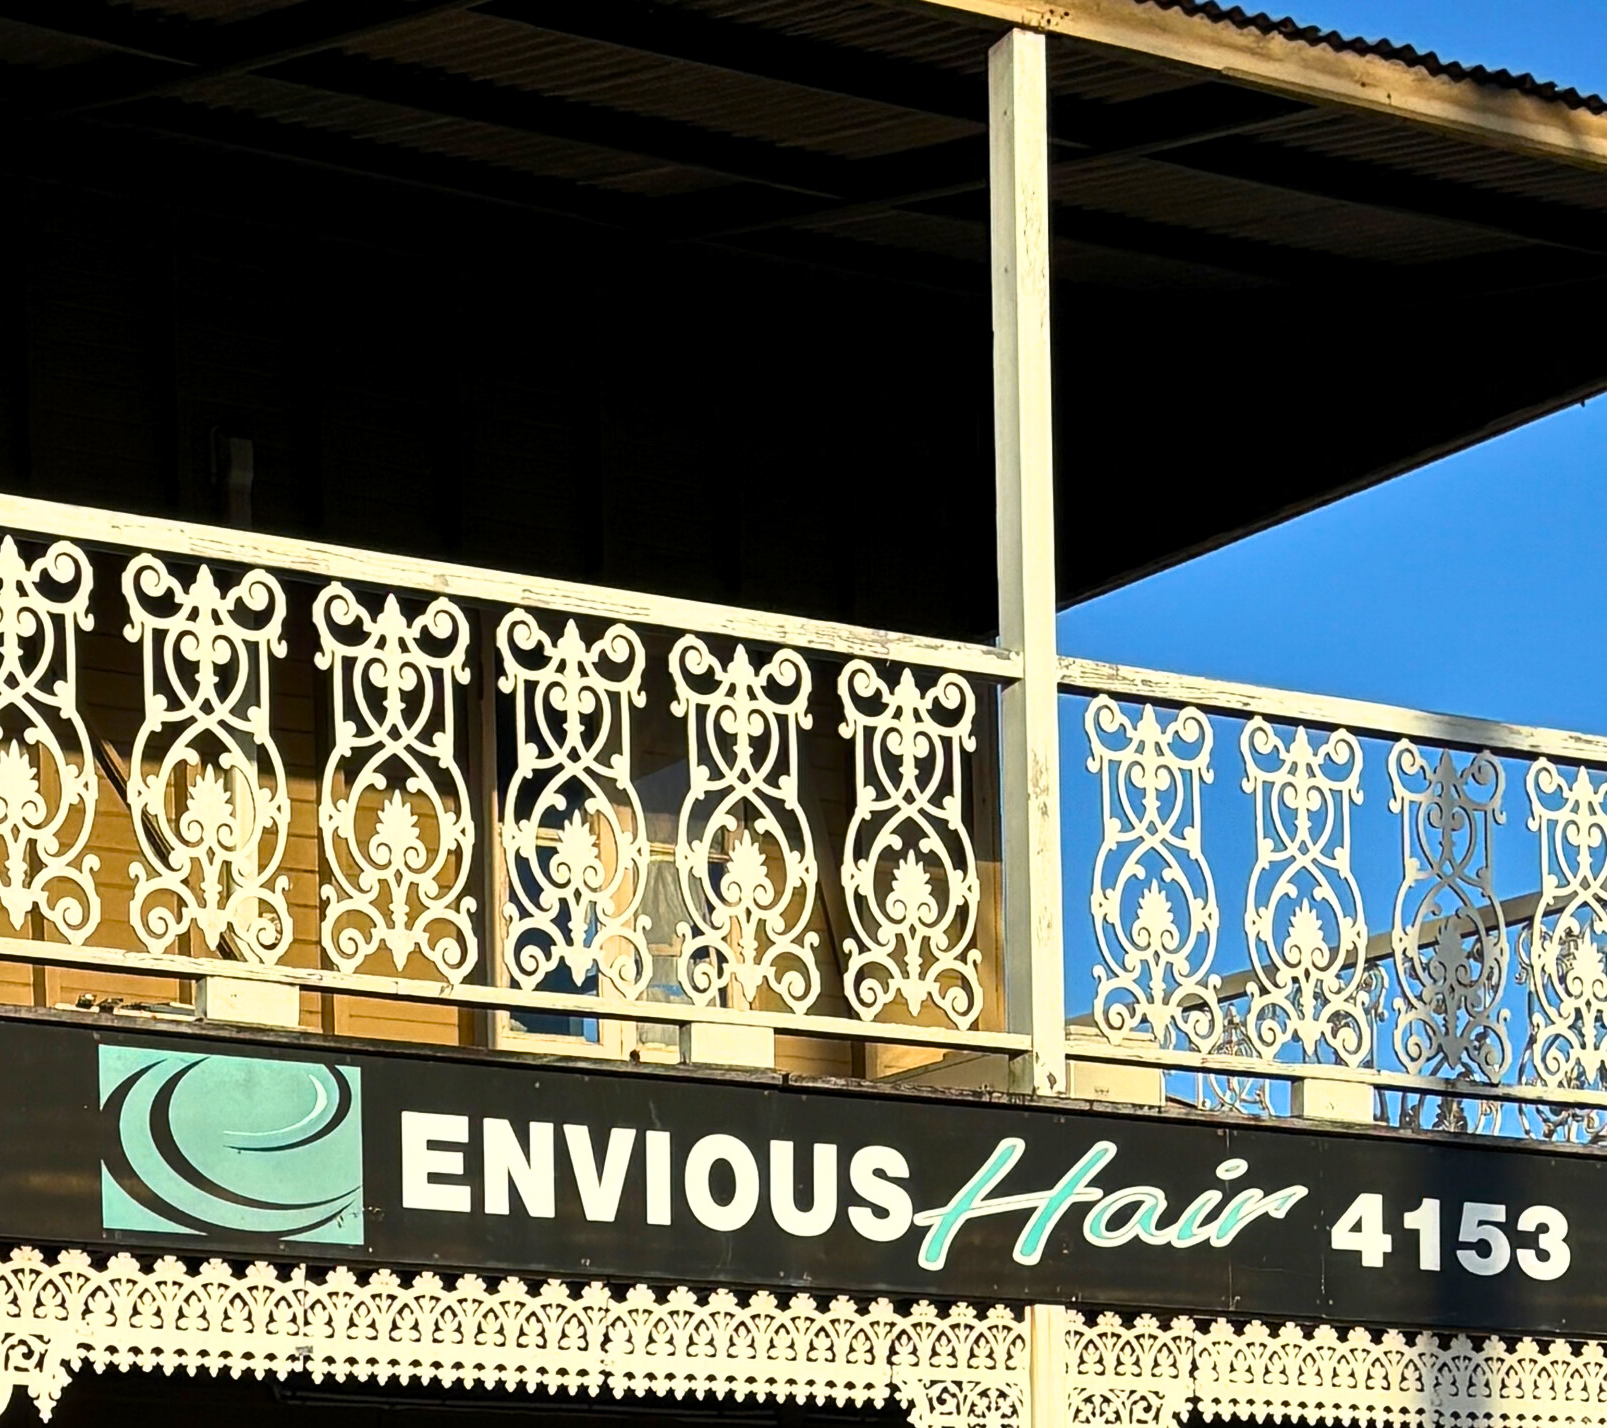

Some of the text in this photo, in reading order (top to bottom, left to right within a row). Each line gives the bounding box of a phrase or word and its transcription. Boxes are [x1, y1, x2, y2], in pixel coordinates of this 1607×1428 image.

[400, 1110, 1572, 1282] ENVIOUS Hair 4153
